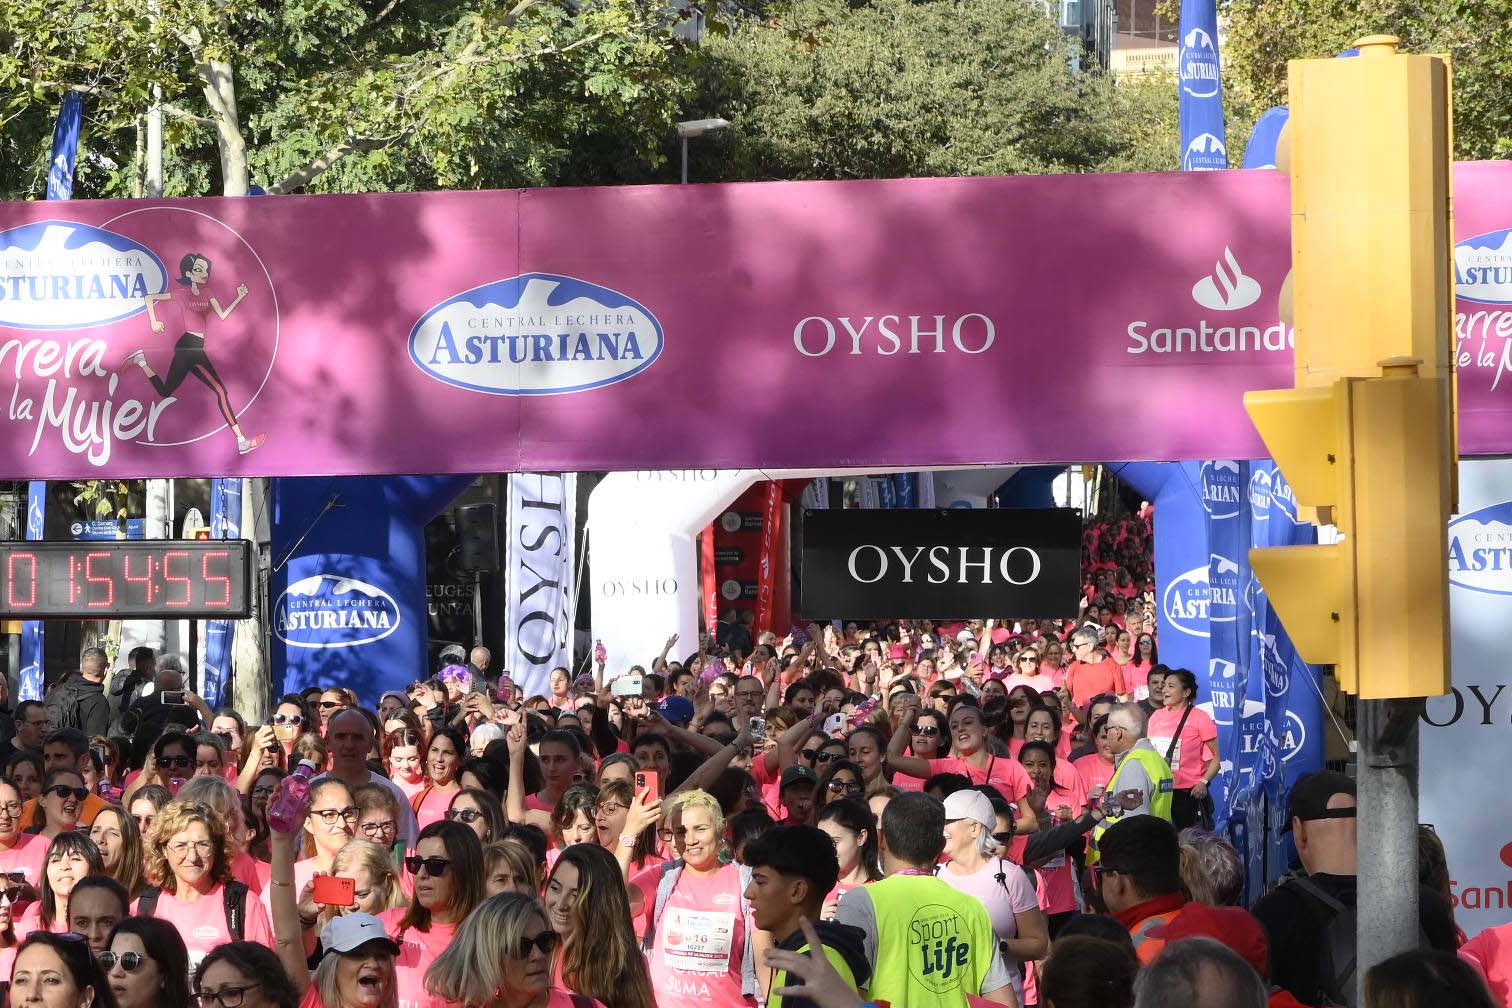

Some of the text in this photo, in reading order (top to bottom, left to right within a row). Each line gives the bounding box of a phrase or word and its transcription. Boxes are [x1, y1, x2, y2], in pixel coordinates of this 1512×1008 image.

[429, 320, 646, 365] ASTURIANA
[468, 314, 635, 329] CENTRAL LECHERA
[793, 314, 995, 357] OYSHO
[7, 382, 34, 421] la
[28, 371, 178, 466] Mujer
[7, 552, 231, 607] 01:54:55
[517, 473, 563, 666] OYSH
[847, 544, 1041, 585] OYSHO
[278, 604, 390, 632] ASTURIANA
[290, 599, 333, 608] CENTRAL
[1419, 684, 1512, 728] OY
[911, 914, 959, 945] Sport
[921, 936, 970, 979] Life
